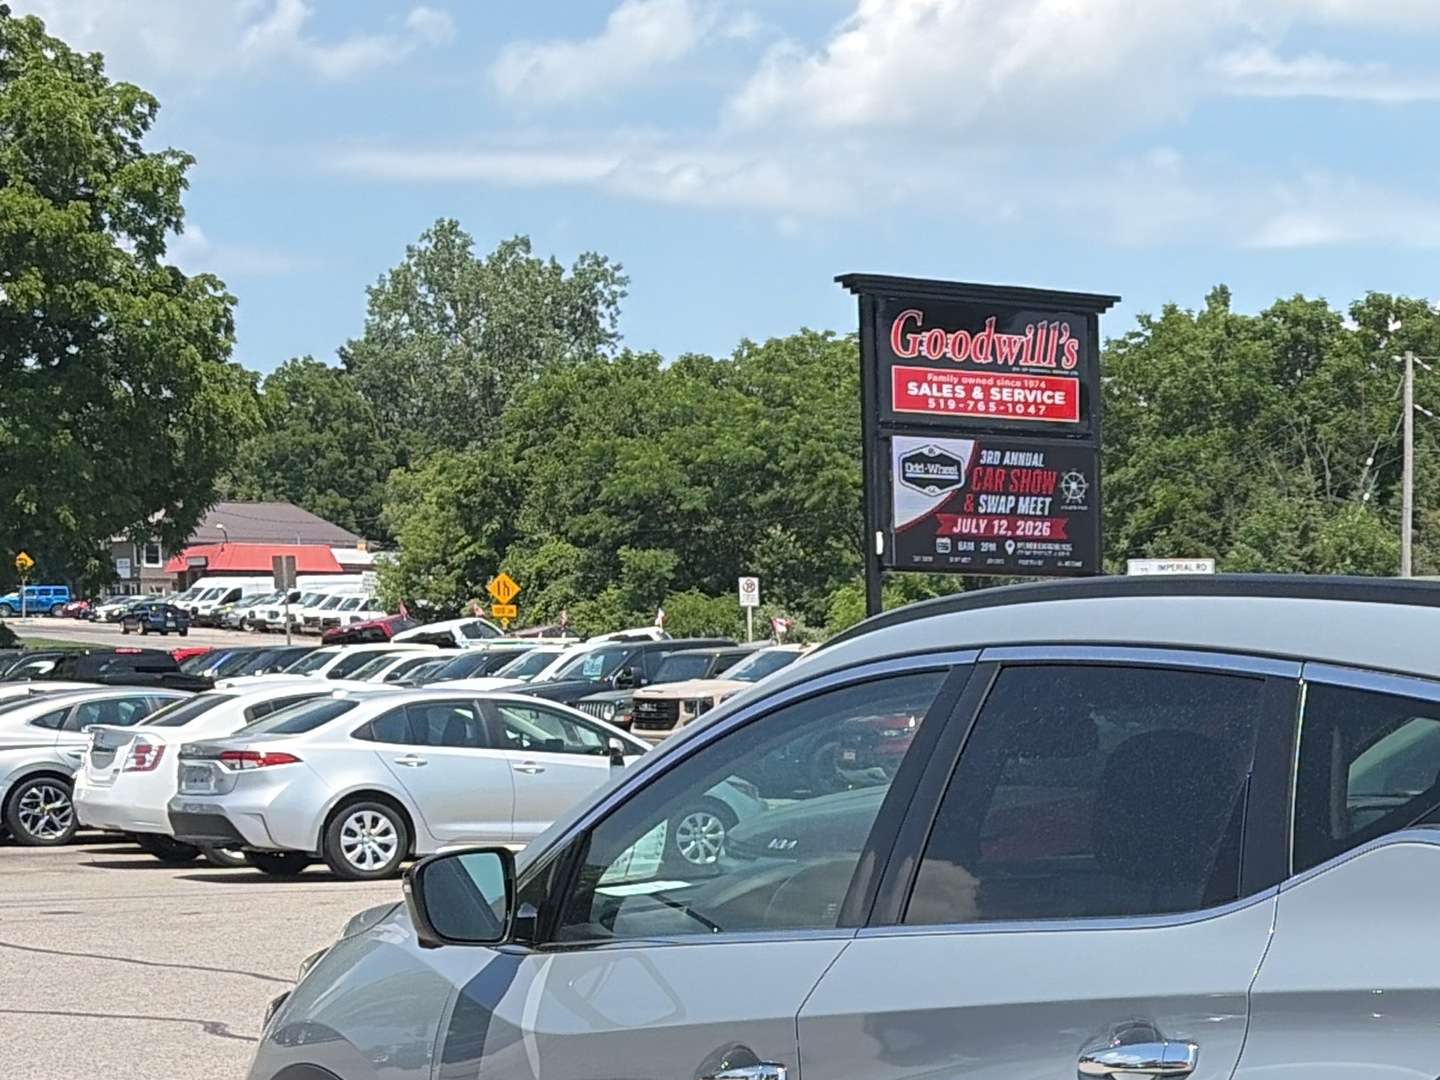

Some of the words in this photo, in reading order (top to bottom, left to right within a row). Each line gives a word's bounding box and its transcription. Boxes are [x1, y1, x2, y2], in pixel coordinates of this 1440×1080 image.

[891, 309, 1079, 370] Goodwill's
[927, 373, 959, 385] Family
[961, 376, 993, 386] owned
[996, 377, 1022, 388] since
[907, 382, 966, 398] SALES
[972, 386, 984, 400] &
[990, 387, 1066, 405] SERVICE
[928, 398, 1047, 415] 519-765-1047
[980, 450, 1001, 465] 3RD
[1003, 451, 1045, 467] ANNUAL
[972, 467, 1006, 492] CAR
[1009, 469, 1057, 495] SHOW
[964, 493, 974, 513] &
[978, 494, 1015, 514] SWAP
[1017, 496, 1052, 516] MEET
[953, 517, 988, 534] JULY
[992, 519, 1012, 537] 12,
[1016, 520, 1051, 537] 2026
